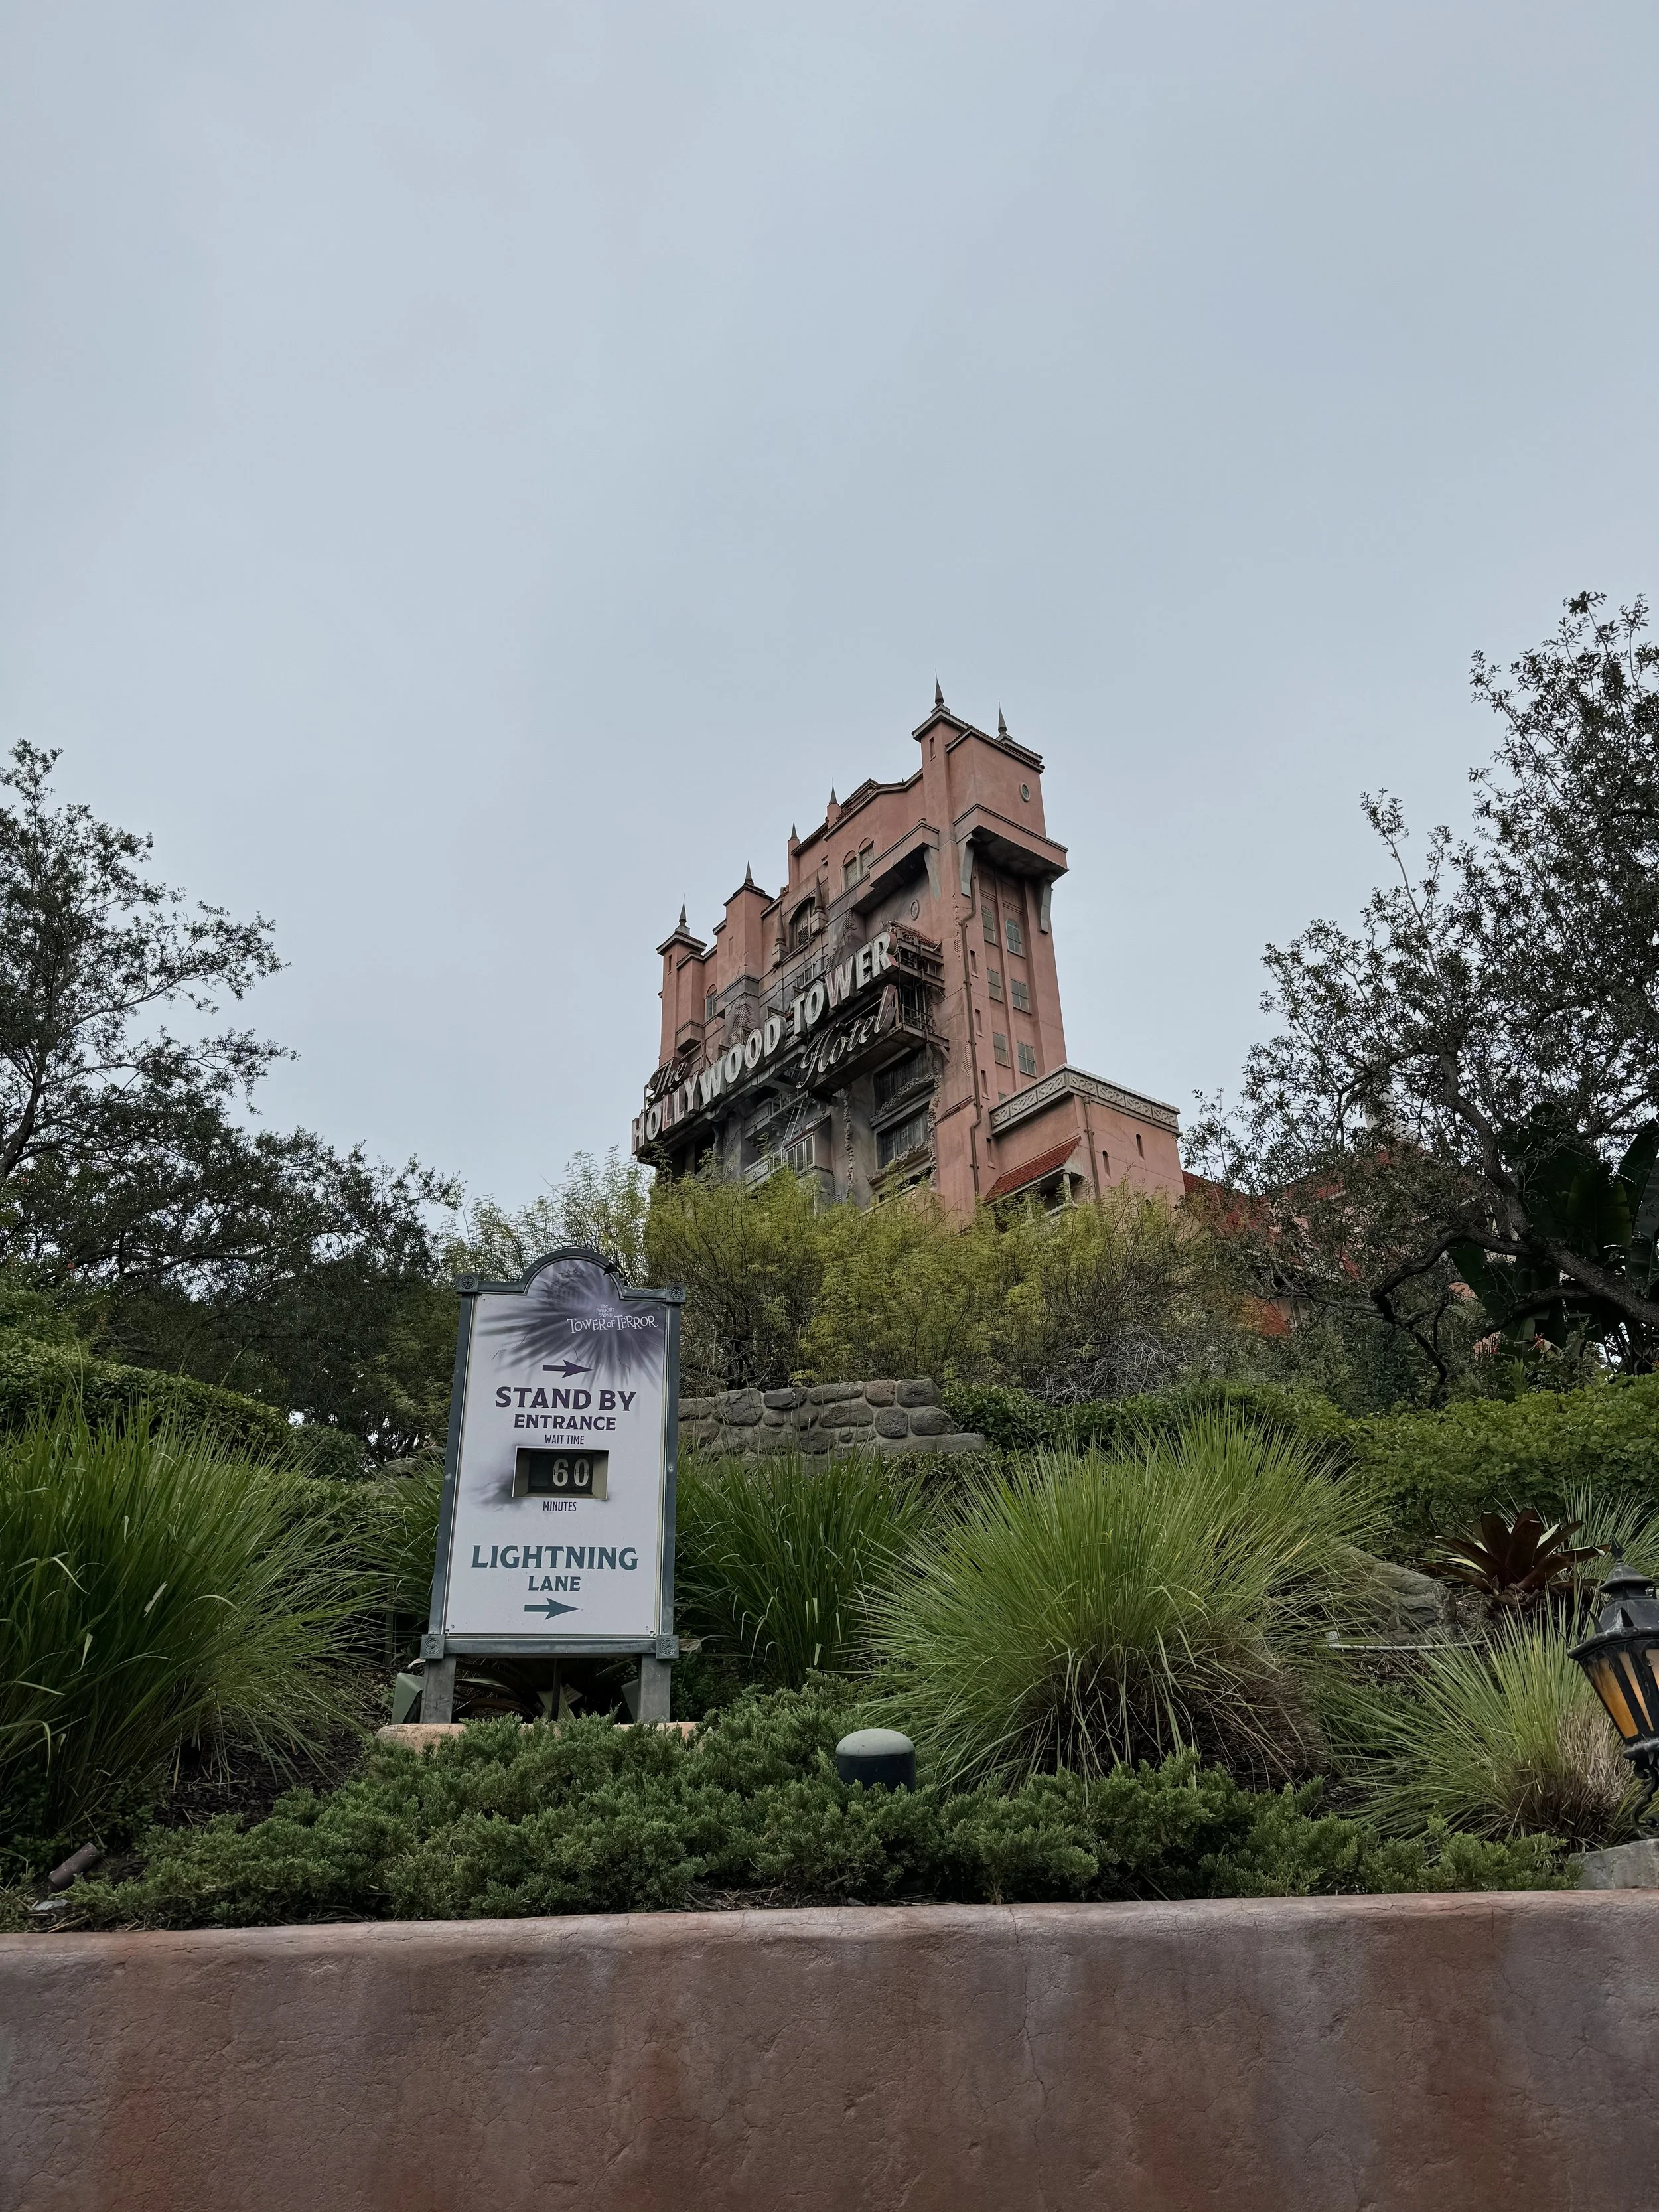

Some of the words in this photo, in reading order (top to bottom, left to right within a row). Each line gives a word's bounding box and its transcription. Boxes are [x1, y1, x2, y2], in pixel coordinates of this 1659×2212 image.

[632, 1015, 787, 1155] HOLLYWOOD
[790, 930, 899, 1036] TOWER
[796, 984, 897, 1089] Hotel
[646, 1058, 687, 1105] The
[567, 1318, 608, 1334] TOWER
[614, 1315, 658, 1330] TERROR
[495, 1386, 592, 1410] STAND
[599, 1389, 638, 1412] BY
[514, 1414, 616, 1431] ENTRANCE
[544, 1434, 564, 1445] WAIT
[566, 1435, 585, 1445] TIME
[553, 1458, 589, 1487] 60
[542, 1501, 577, 1512] MINUTES
[470, 1544, 639, 1571] LIGHTNING
[528, 1575, 581, 1592] LANE
